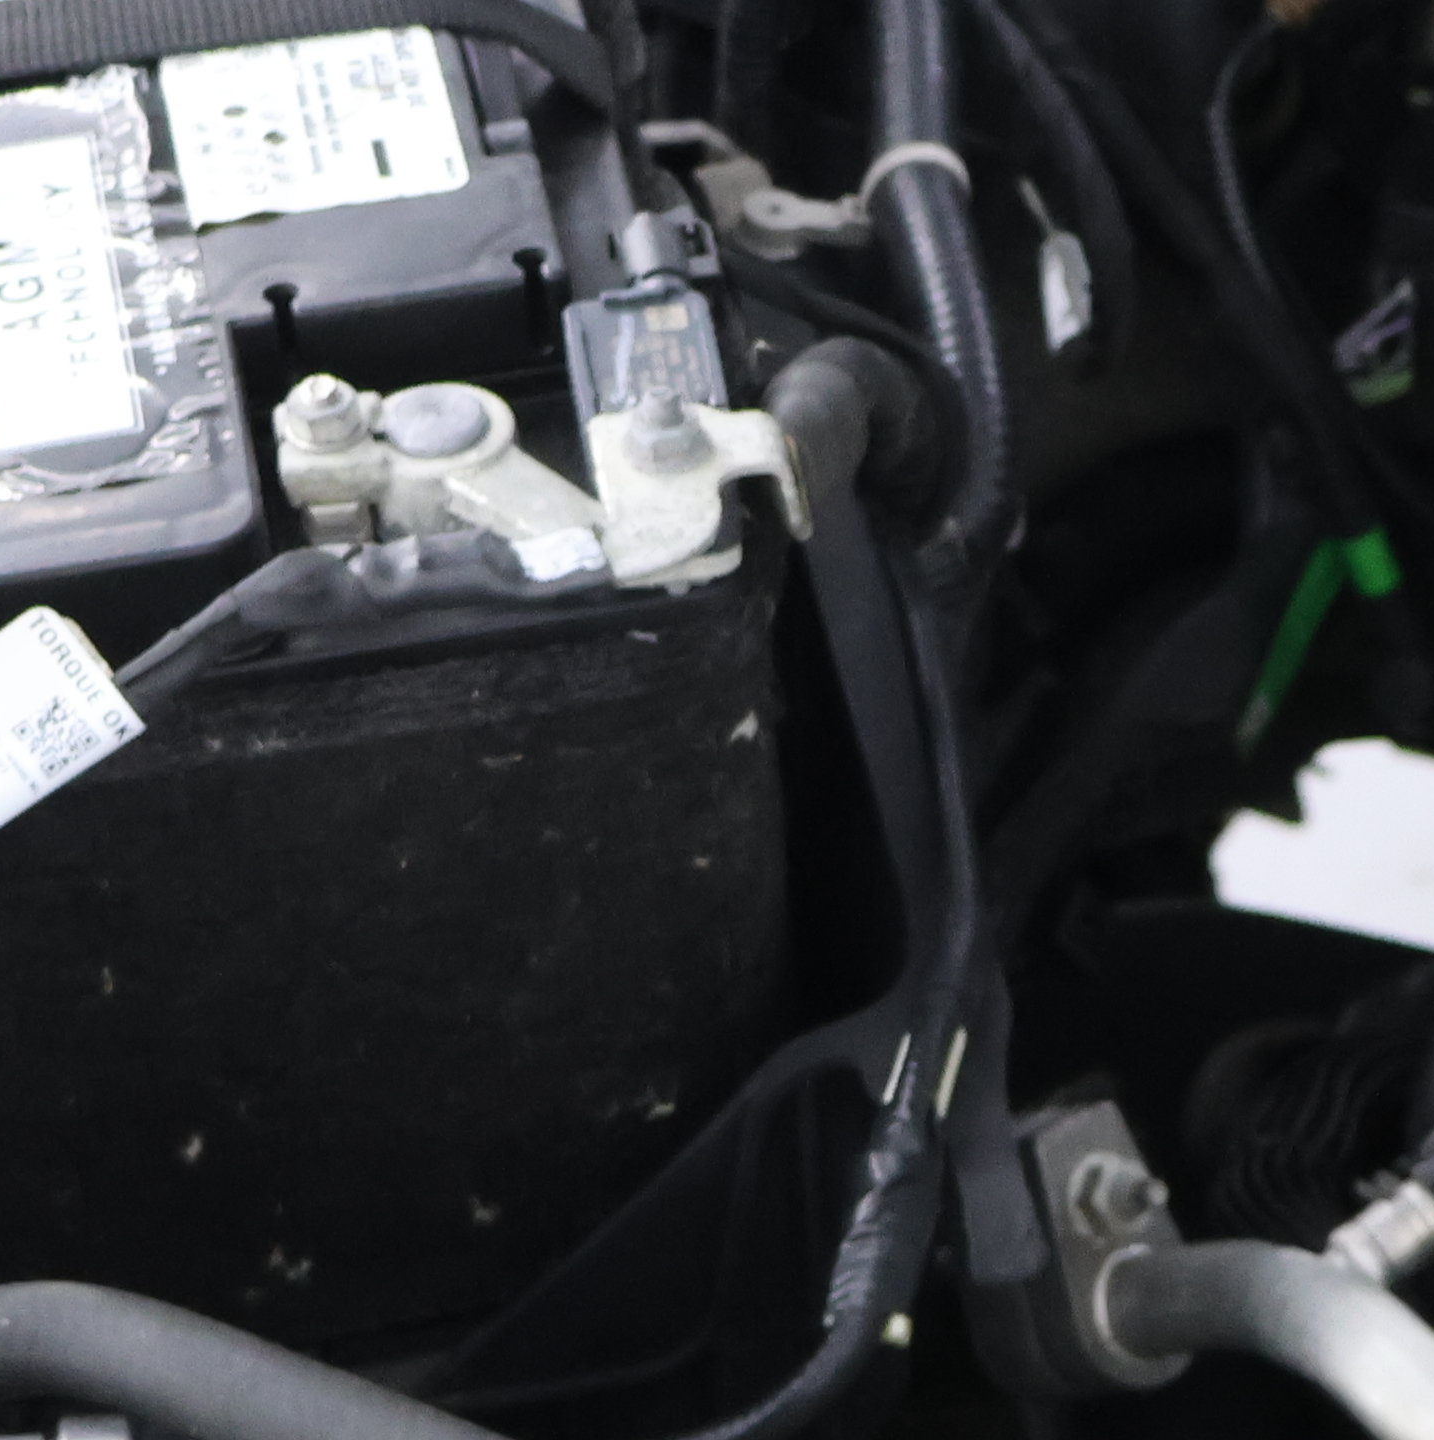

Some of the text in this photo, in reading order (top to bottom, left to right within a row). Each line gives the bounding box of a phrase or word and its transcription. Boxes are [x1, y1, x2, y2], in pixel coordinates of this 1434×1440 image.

[42, 181, 98, 378] ECHNOLGY
[29, 613, 130, 743] TORQUE OK
